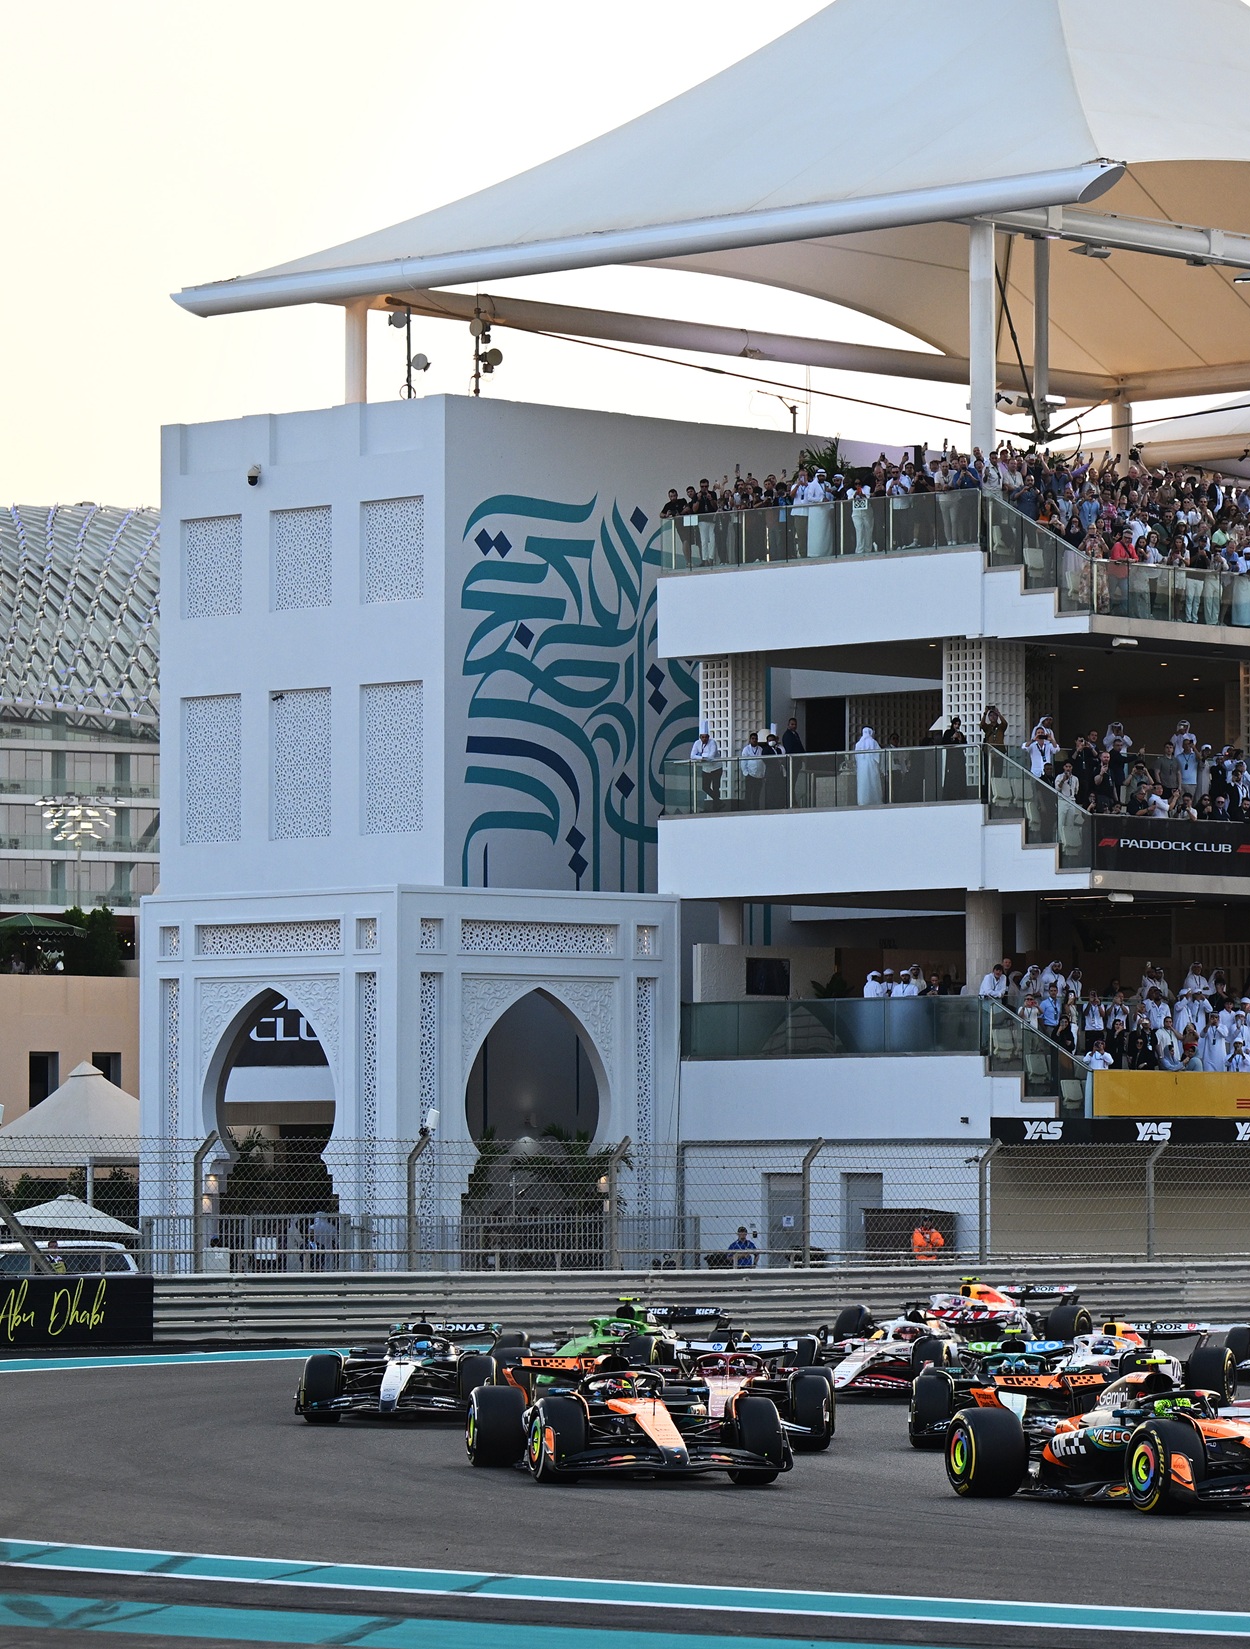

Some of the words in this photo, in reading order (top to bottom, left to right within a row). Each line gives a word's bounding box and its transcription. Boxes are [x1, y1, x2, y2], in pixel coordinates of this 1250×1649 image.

[1119, 838, 1192, 852] PADDOCK
[1194, 842, 1232, 853] CLUB
[1023, 1121, 1063, 1140] YAS
[1135, 1122, 1172, 1141] YAS
[0, 1279, 34, 1342] Abu
[48, 1277, 107, 1336] Dhabi
[408, 1323, 486, 1332] PRONAS
[972, 1341, 1059, 1352] arco
[1099, 1387, 1129, 1406] Gemini
[1094, 1429, 1132, 1443] VELO
